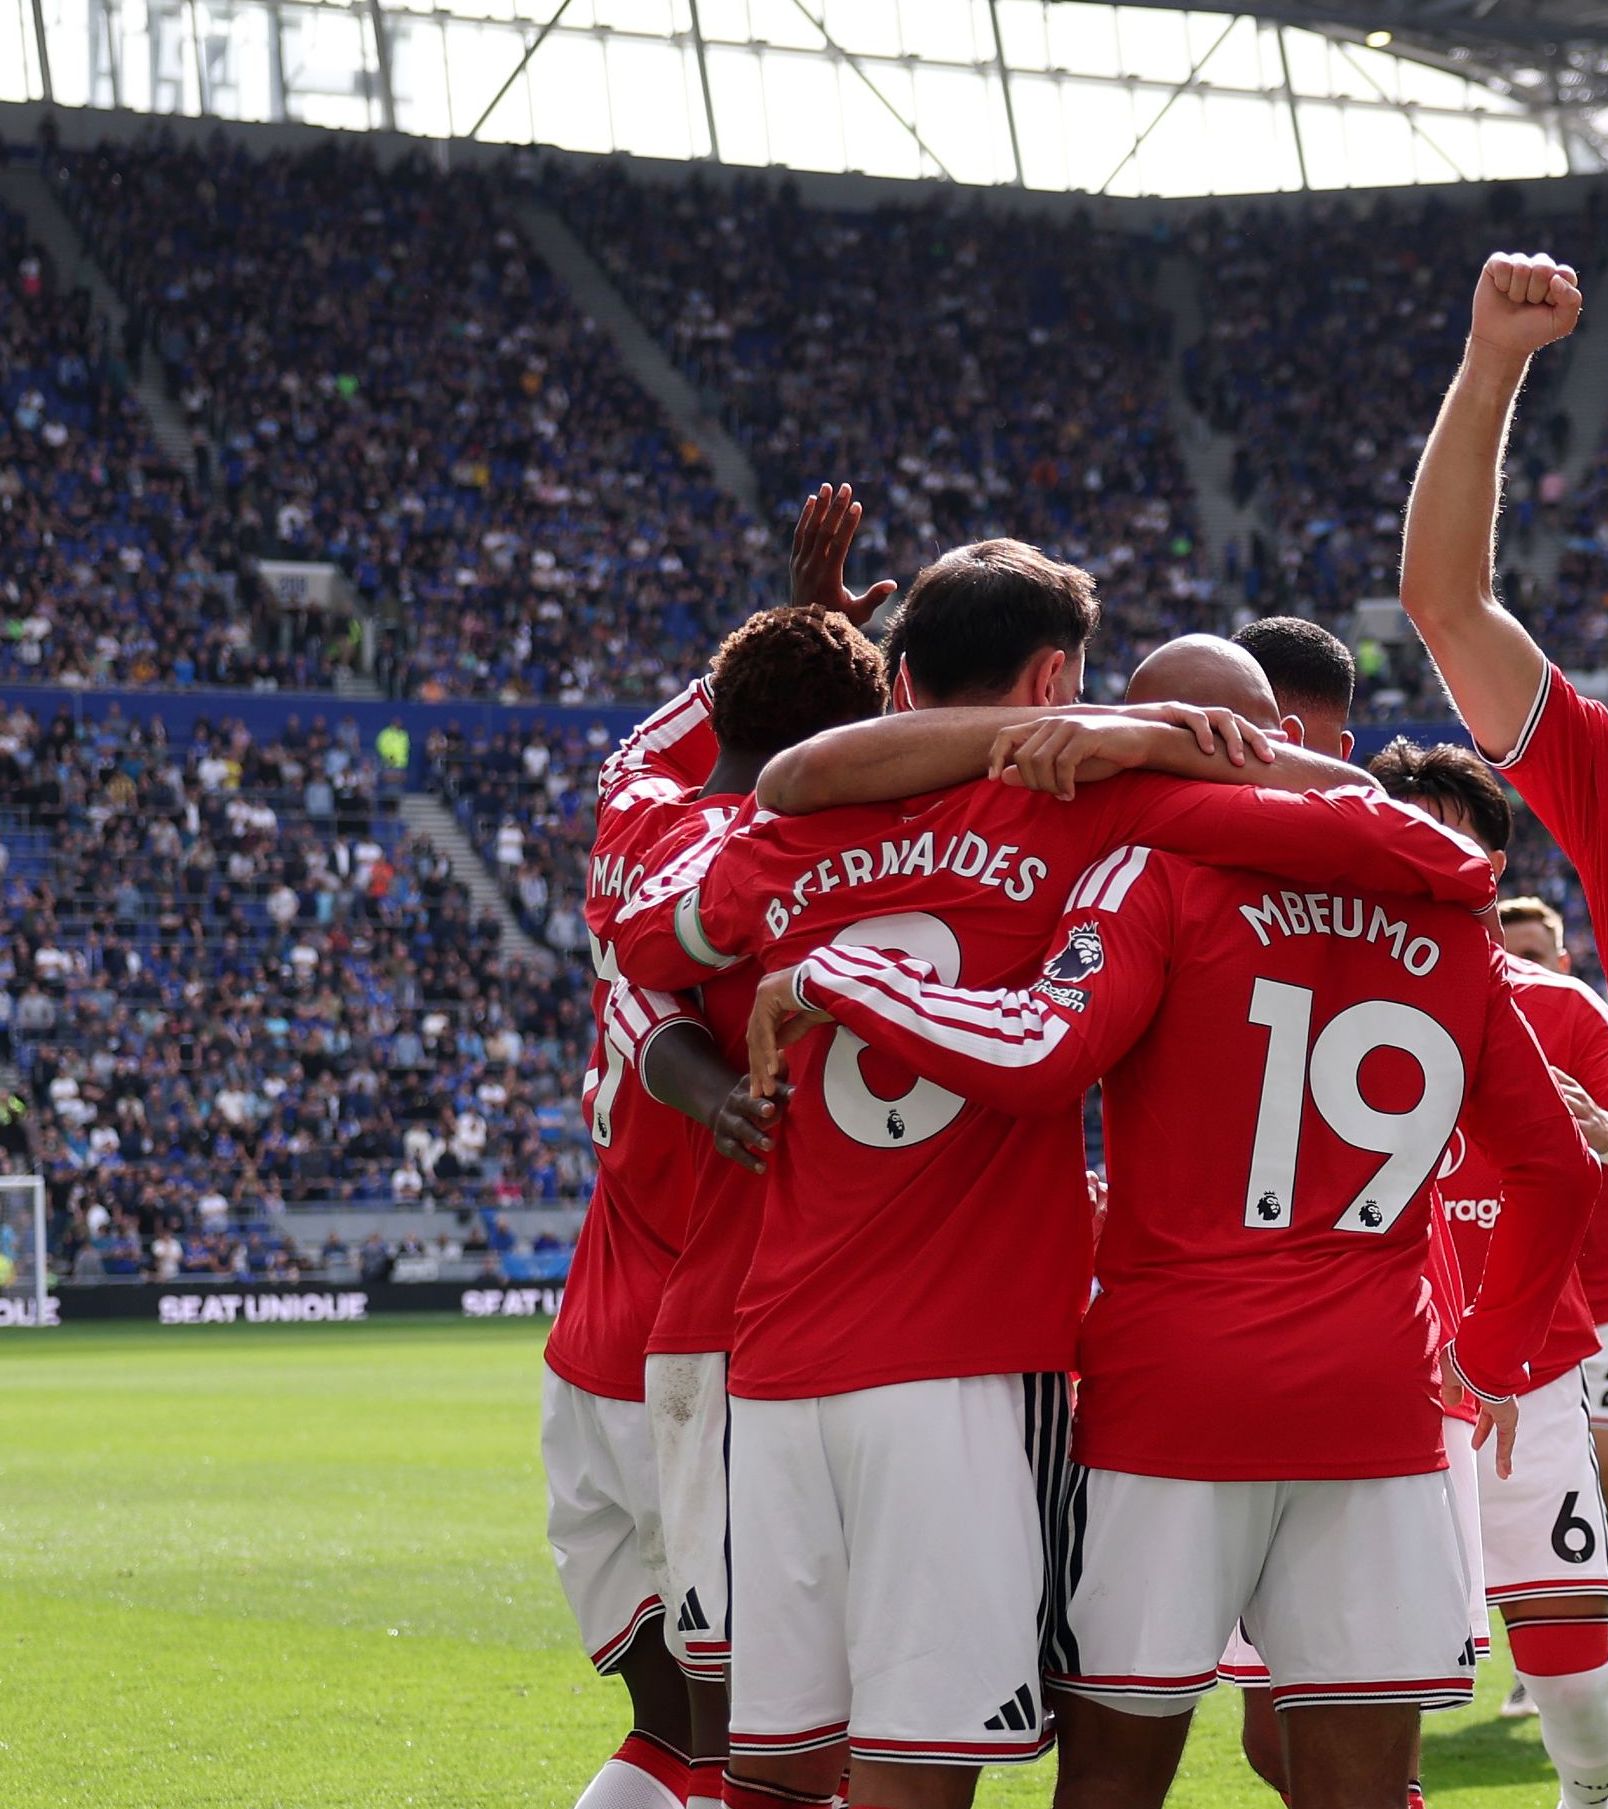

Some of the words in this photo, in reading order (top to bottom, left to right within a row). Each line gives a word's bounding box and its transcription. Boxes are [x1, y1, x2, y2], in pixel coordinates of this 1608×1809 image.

[1239, 890, 1441, 977] MBEUMO
[1243, 976, 1465, 1235] 19
[158, 1295, 243, 1325] SEAT
[244, 1292, 368, 1322] UNIQUE
[461, 1288, 541, 1317] SEAT
[1551, 1491, 1596, 1564] 6
